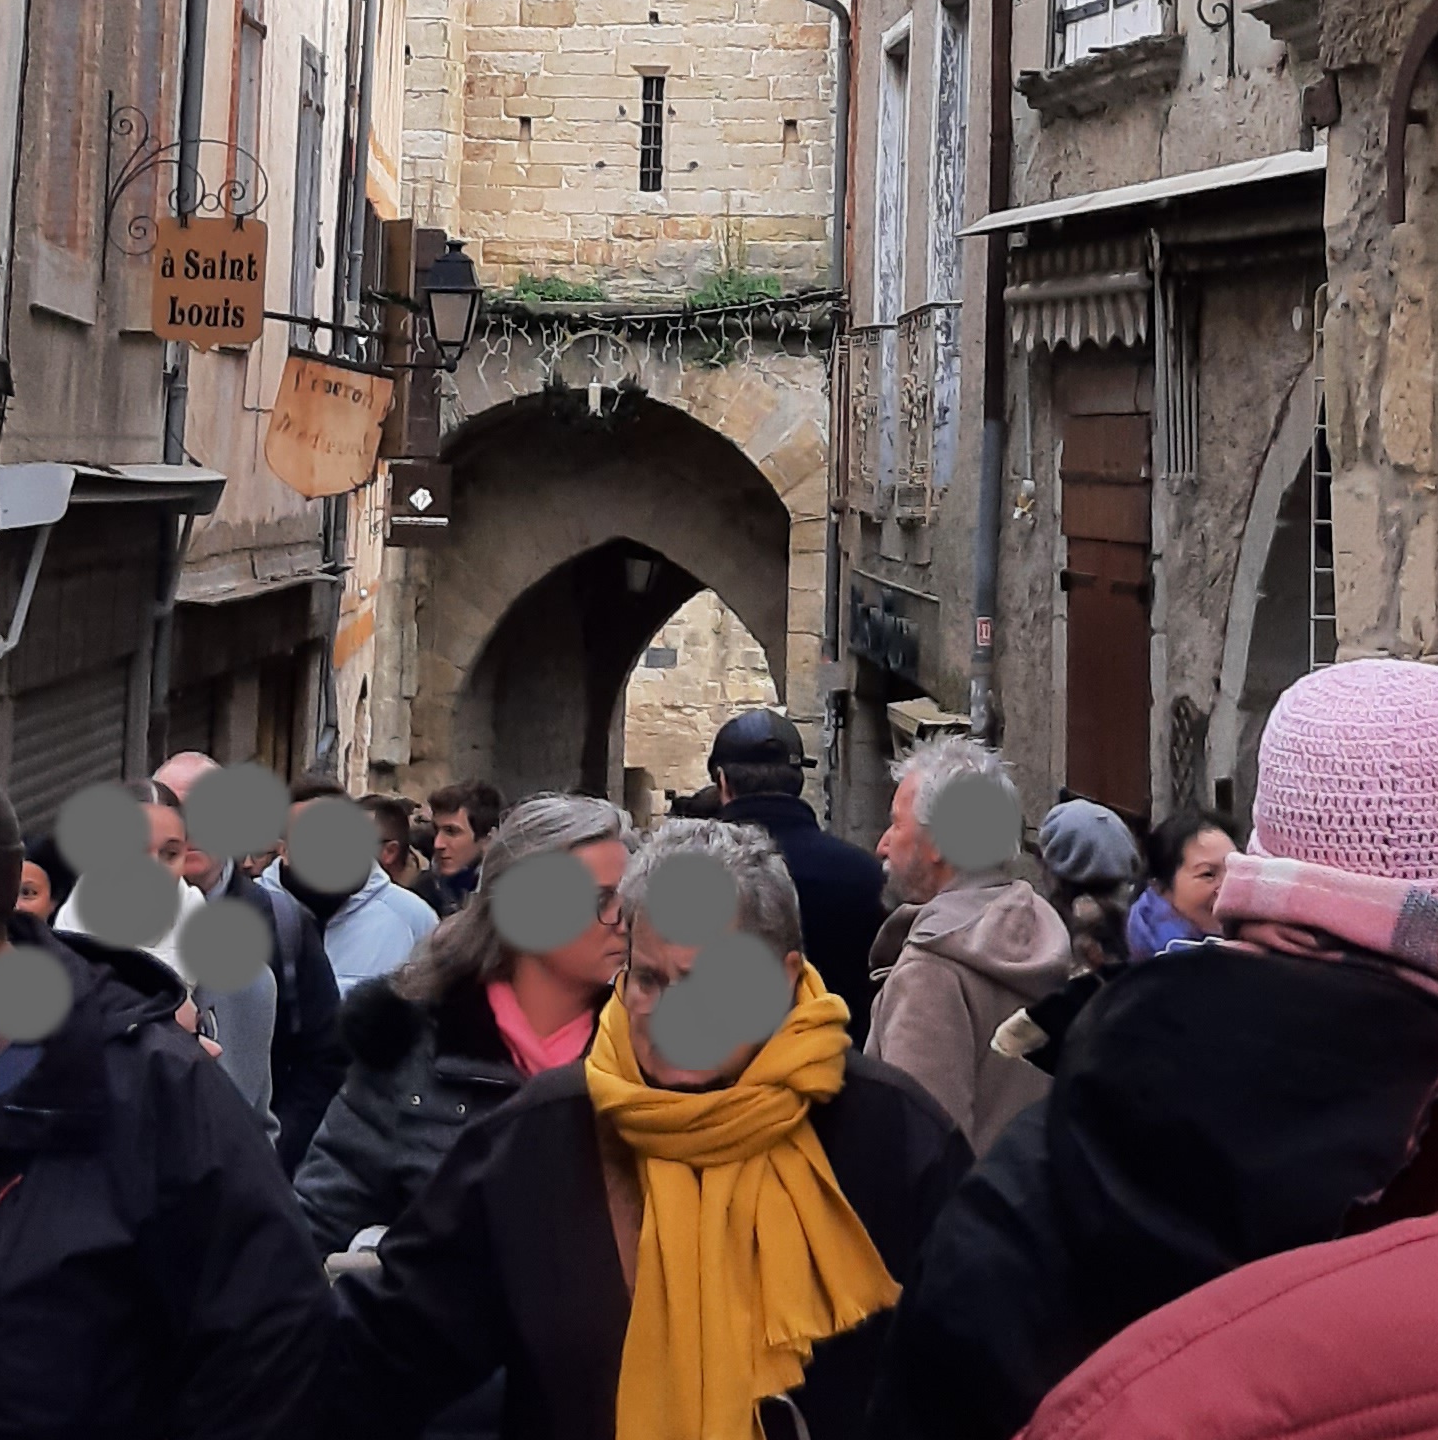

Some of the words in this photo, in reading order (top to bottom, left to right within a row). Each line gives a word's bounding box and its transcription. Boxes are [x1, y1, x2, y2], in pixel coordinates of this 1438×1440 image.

[161, 250, 175, 278] à
[184, 249, 258, 281] Saint
[168, 296, 245, 327] Louis
